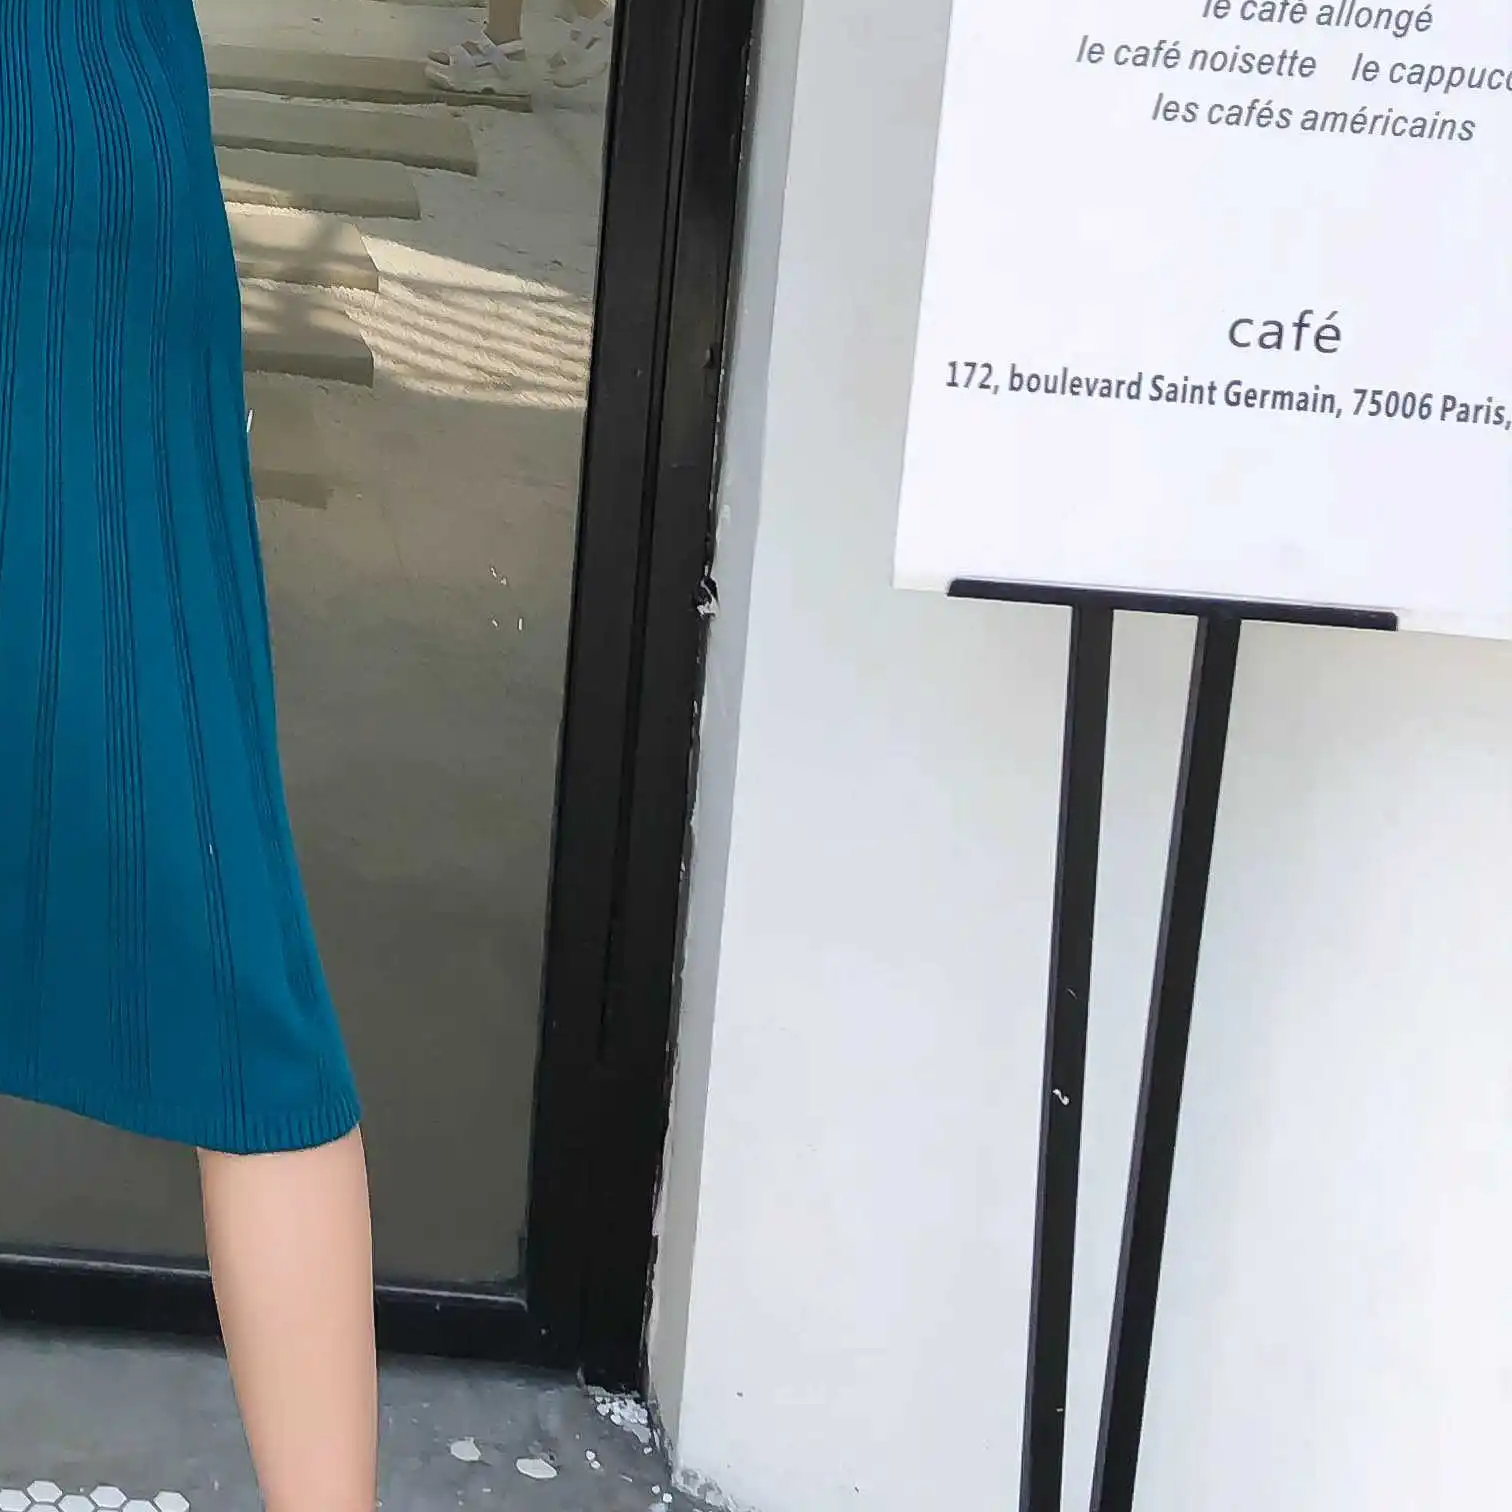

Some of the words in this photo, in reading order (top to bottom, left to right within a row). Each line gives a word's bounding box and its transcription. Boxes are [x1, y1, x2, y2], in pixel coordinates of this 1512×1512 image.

[1077, 35, 1106, 64] le
[1114, 39, 1182, 69] café
[1188, 45, 1318, 78] noisette
[1351, 52, 1381, 82] le
[1152, 92, 1200, 123] les
[1208, 98, 1294, 129] cafés
[1300, 106, 1477, 142] américains
[1228, 309, 1343, 354] café
[946, 360, 1000, 395] 172,
[1008, 363, 1144, 401] boulevard
[1149, 374, 1218, 406] Saint
[1224, 379, 1343, 419] Germain,
[1353, 388, 1434, 421] 75006
[1440, 394, 1512, 431] Paris,
